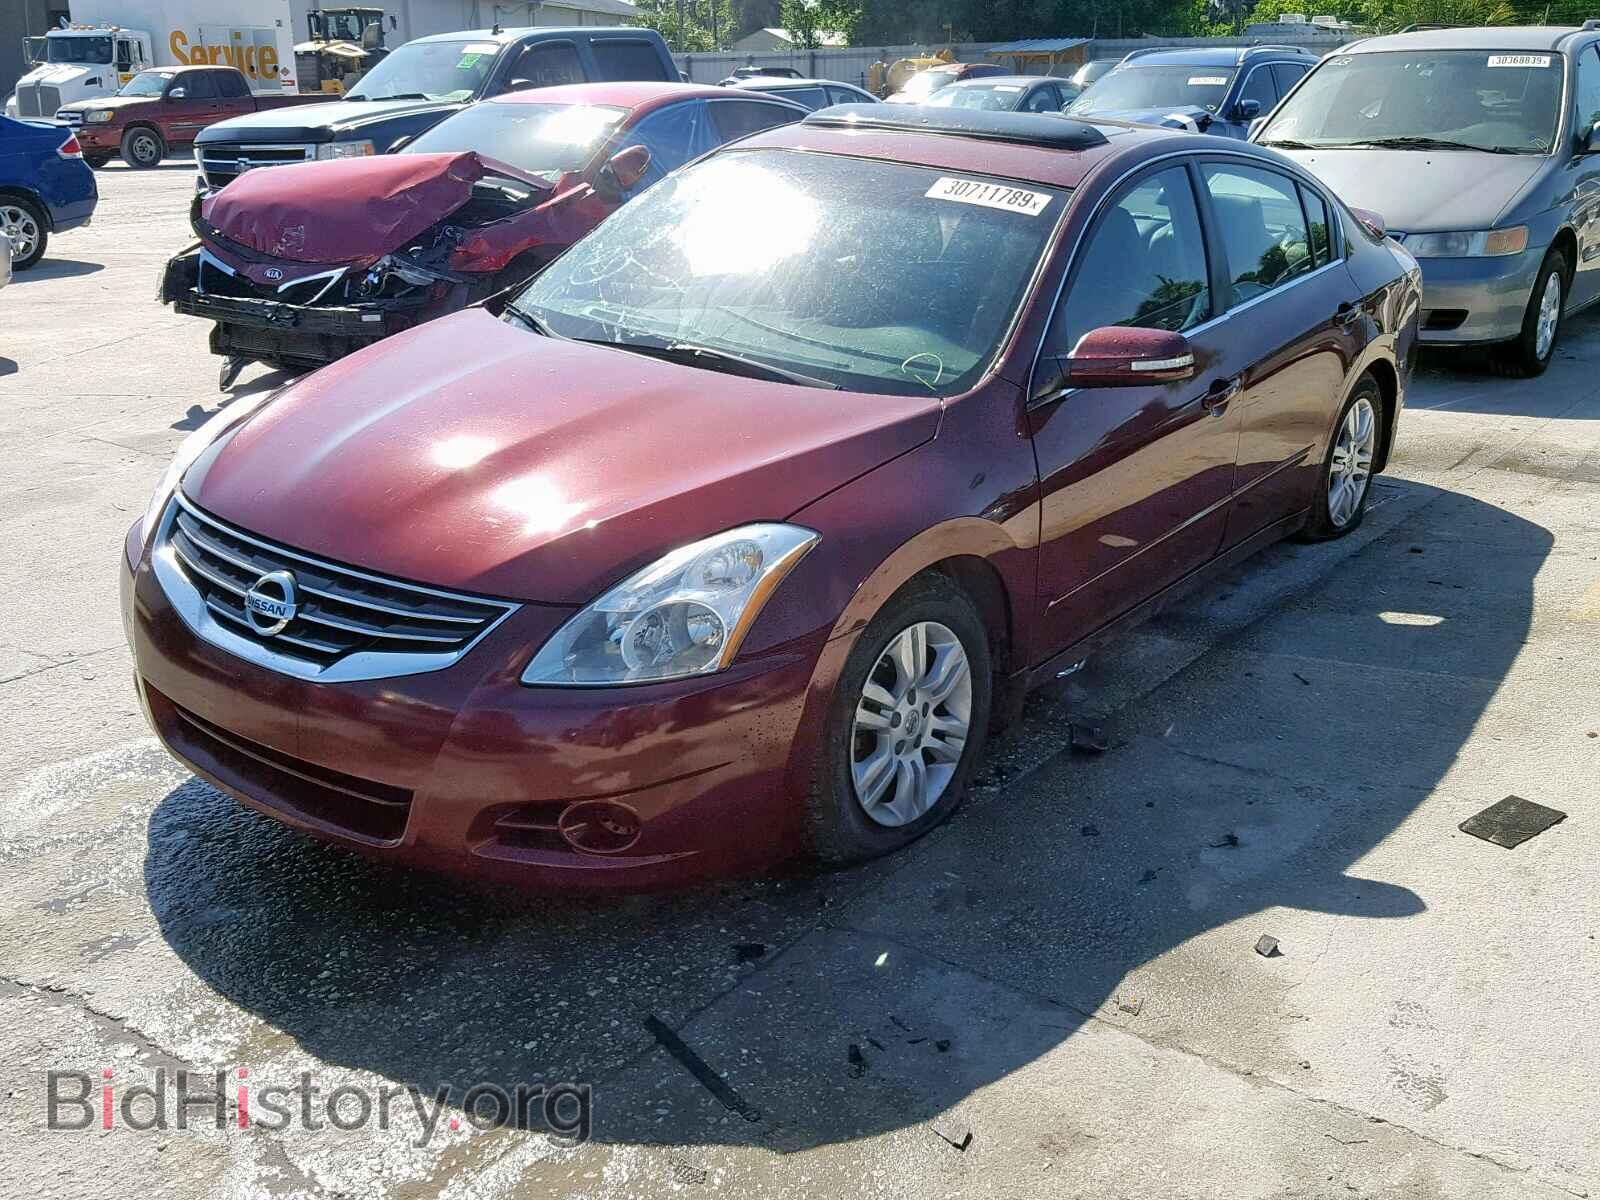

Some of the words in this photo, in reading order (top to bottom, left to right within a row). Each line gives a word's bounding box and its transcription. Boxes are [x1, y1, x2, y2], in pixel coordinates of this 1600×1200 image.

[169, 30, 279, 79] Service
[264, 270, 280, 279] KIA
[247, 594, 286, 616] NISSAN
